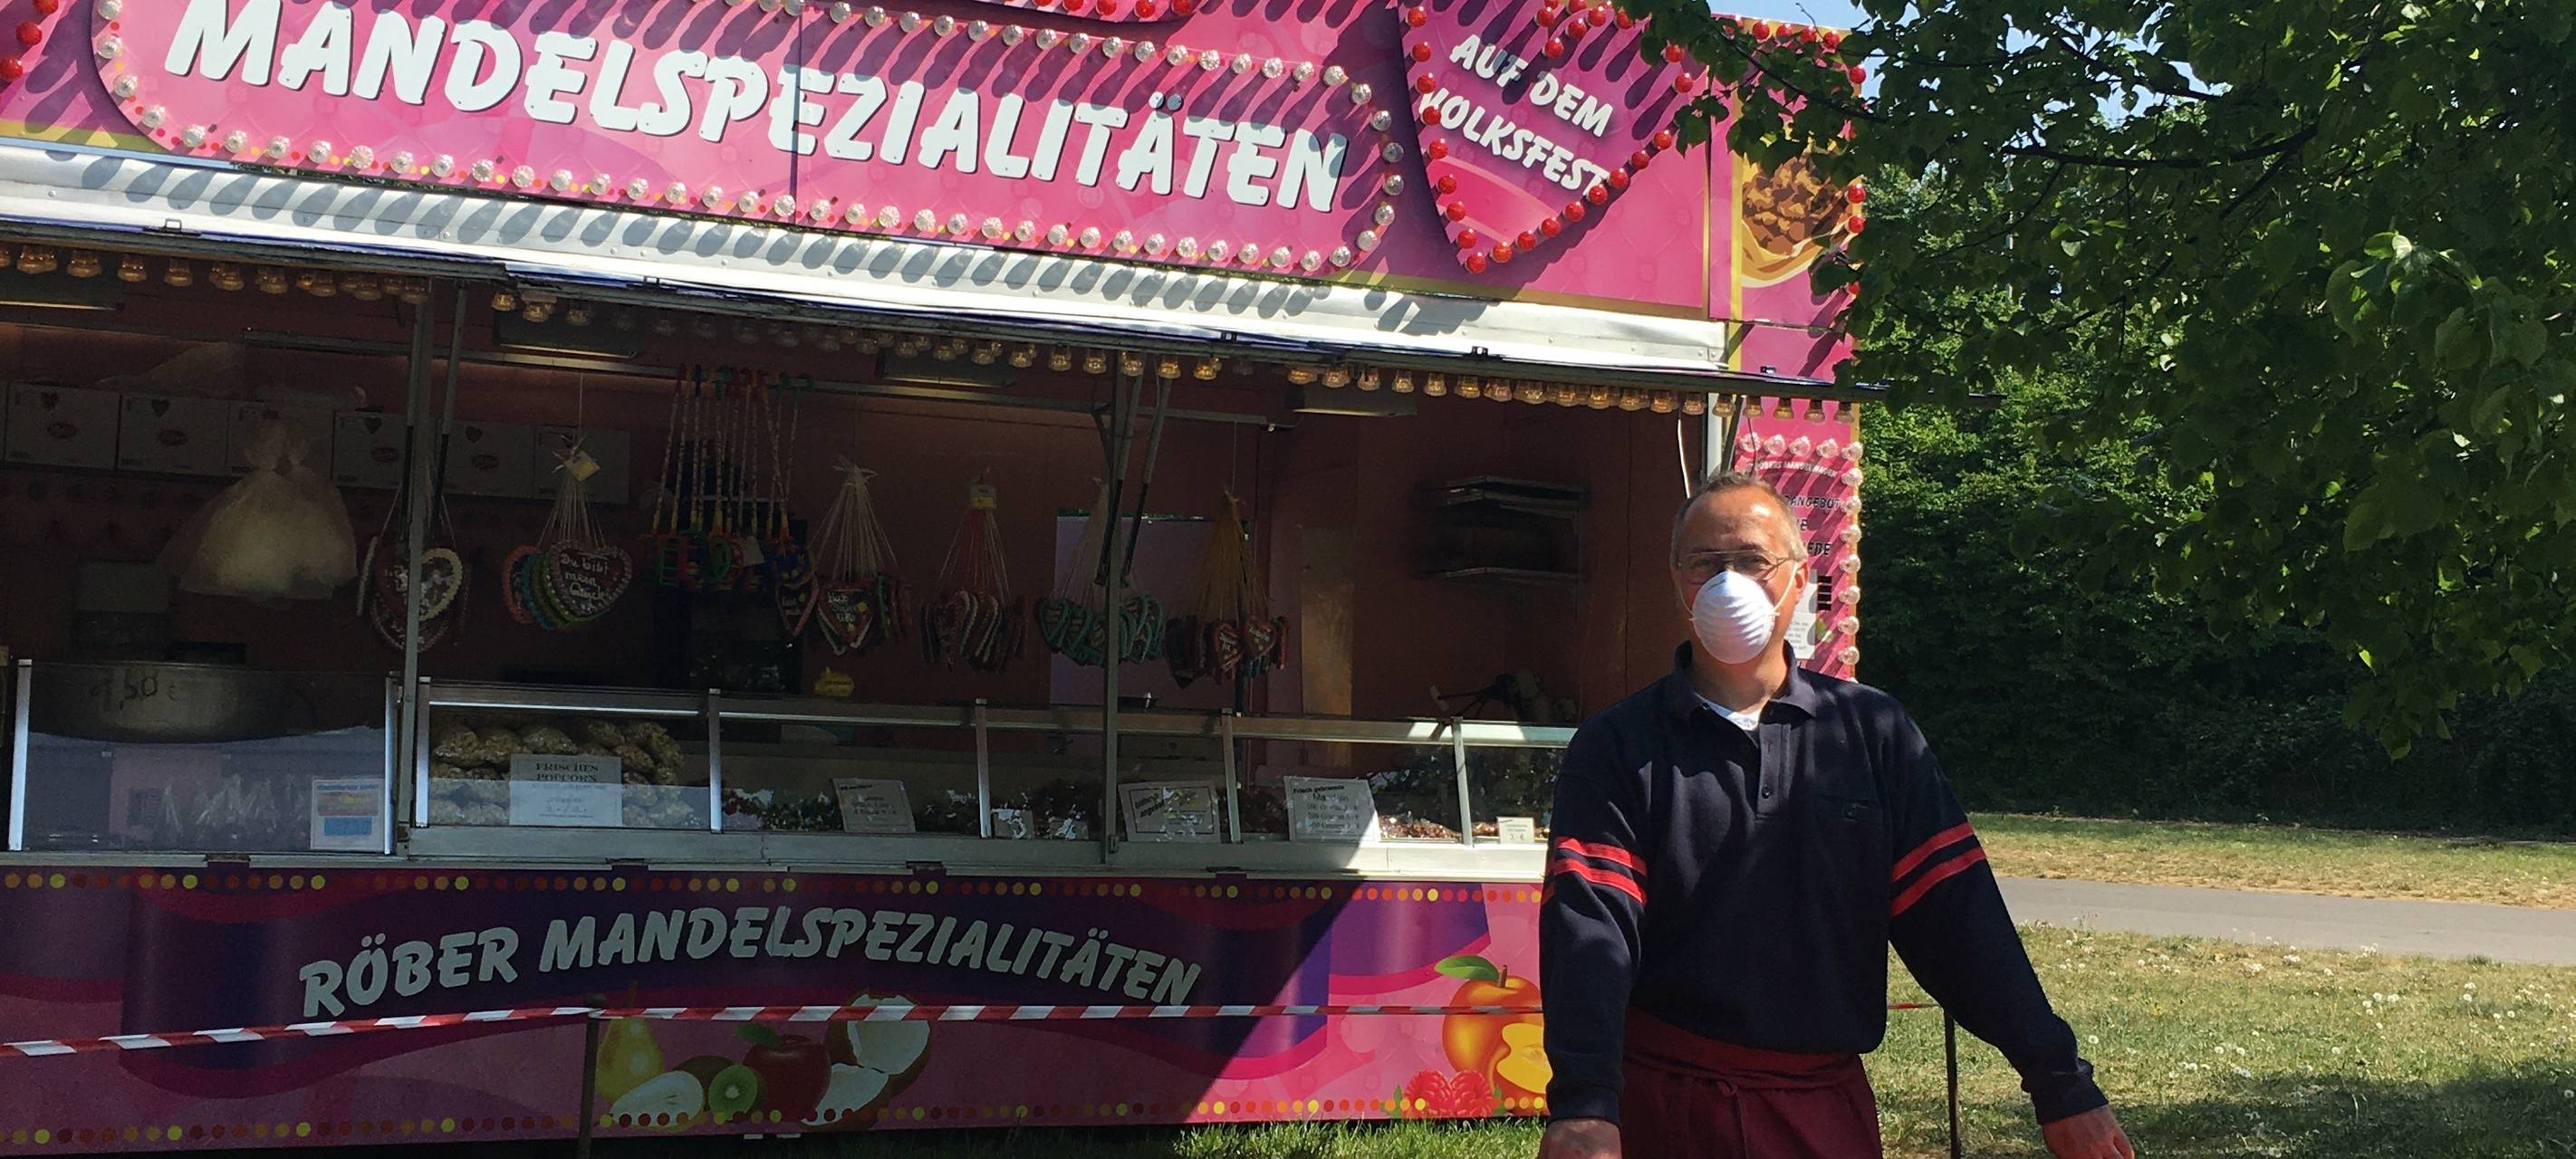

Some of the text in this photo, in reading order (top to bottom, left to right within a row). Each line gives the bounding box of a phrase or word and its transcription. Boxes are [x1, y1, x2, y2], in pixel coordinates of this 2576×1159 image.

[163, 0, 1349, 213] MANDELSPEZIALITÄTEN
[1449, 34, 1614, 138] AUF DEM
[1785, 495, 1841, 509] ANGEBOT
[299, 905, 1203, 1020] RÖBER MANDELSPEZIALITÄTEN
